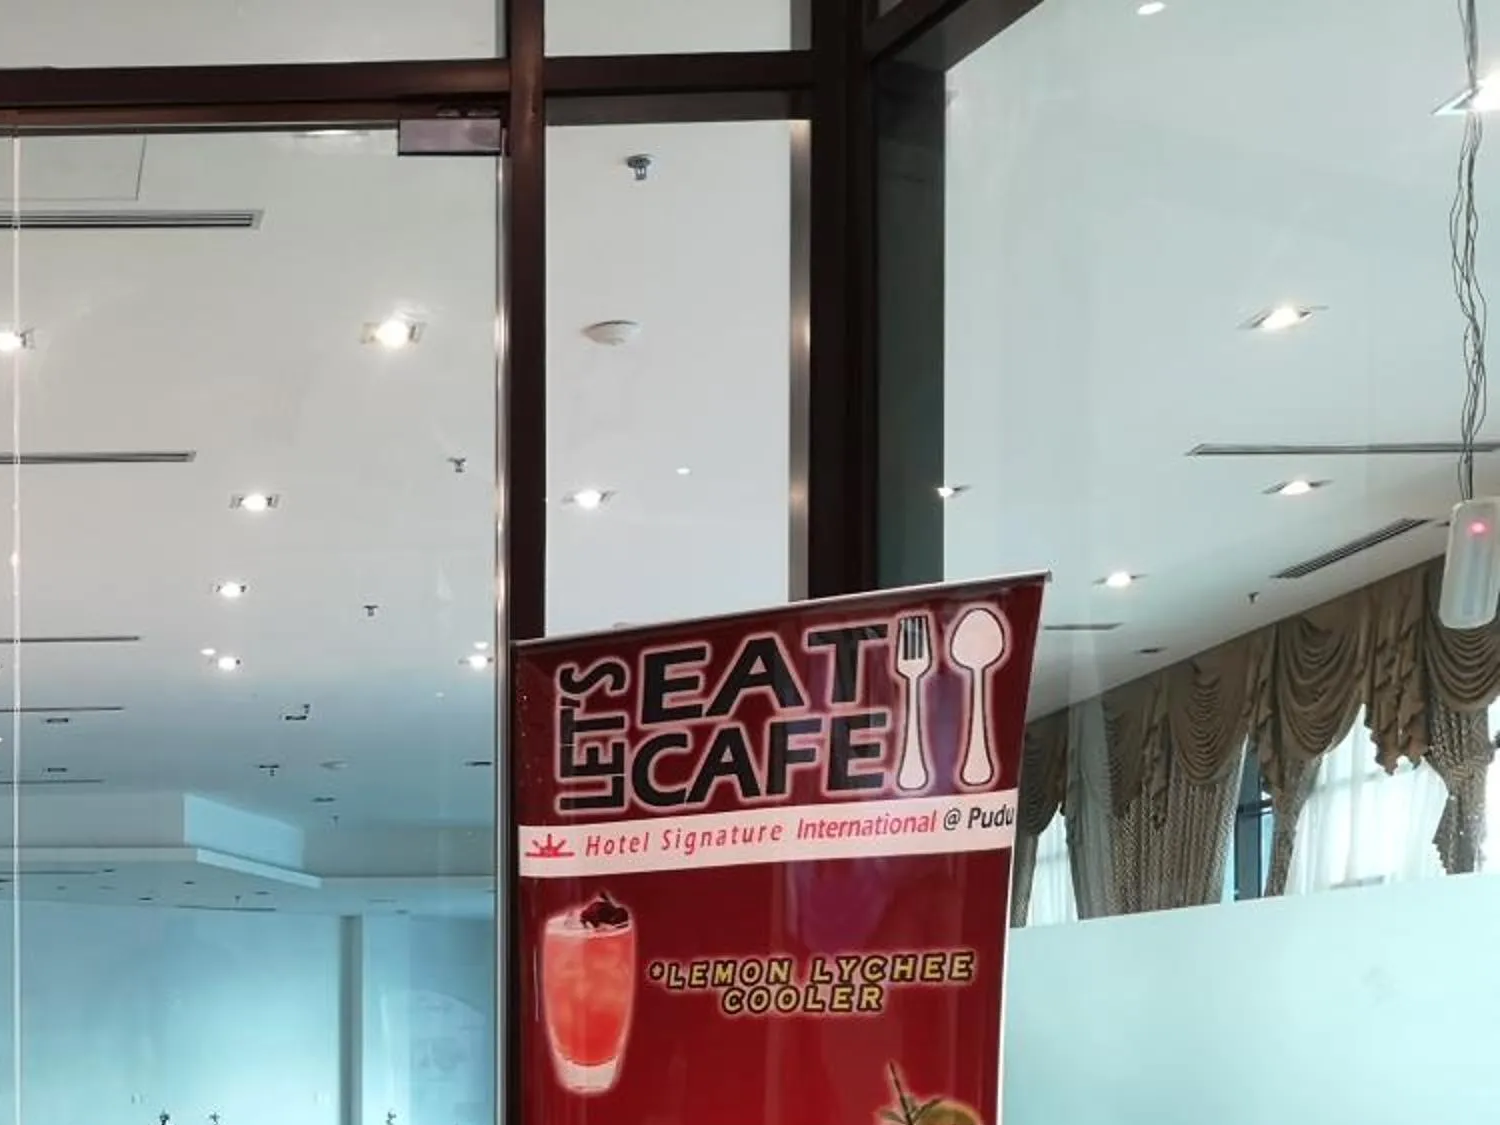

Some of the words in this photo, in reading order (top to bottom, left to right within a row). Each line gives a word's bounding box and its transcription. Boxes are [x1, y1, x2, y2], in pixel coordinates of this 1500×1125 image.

[640, 623, 889, 725] EAT
[558, 660, 627, 811] LET'S
[631, 712, 889, 807] CAFE
[585, 831, 648, 857] Hotel
[661, 821, 782, 858] Signature
[797, 810, 937, 839] International
[944, 808, 961, 831] @
[967, 804, 1014, 828] Pudu
[721, 981, 883, 1014] COOLER
[812, 950, 975, 985] LYCHEE
